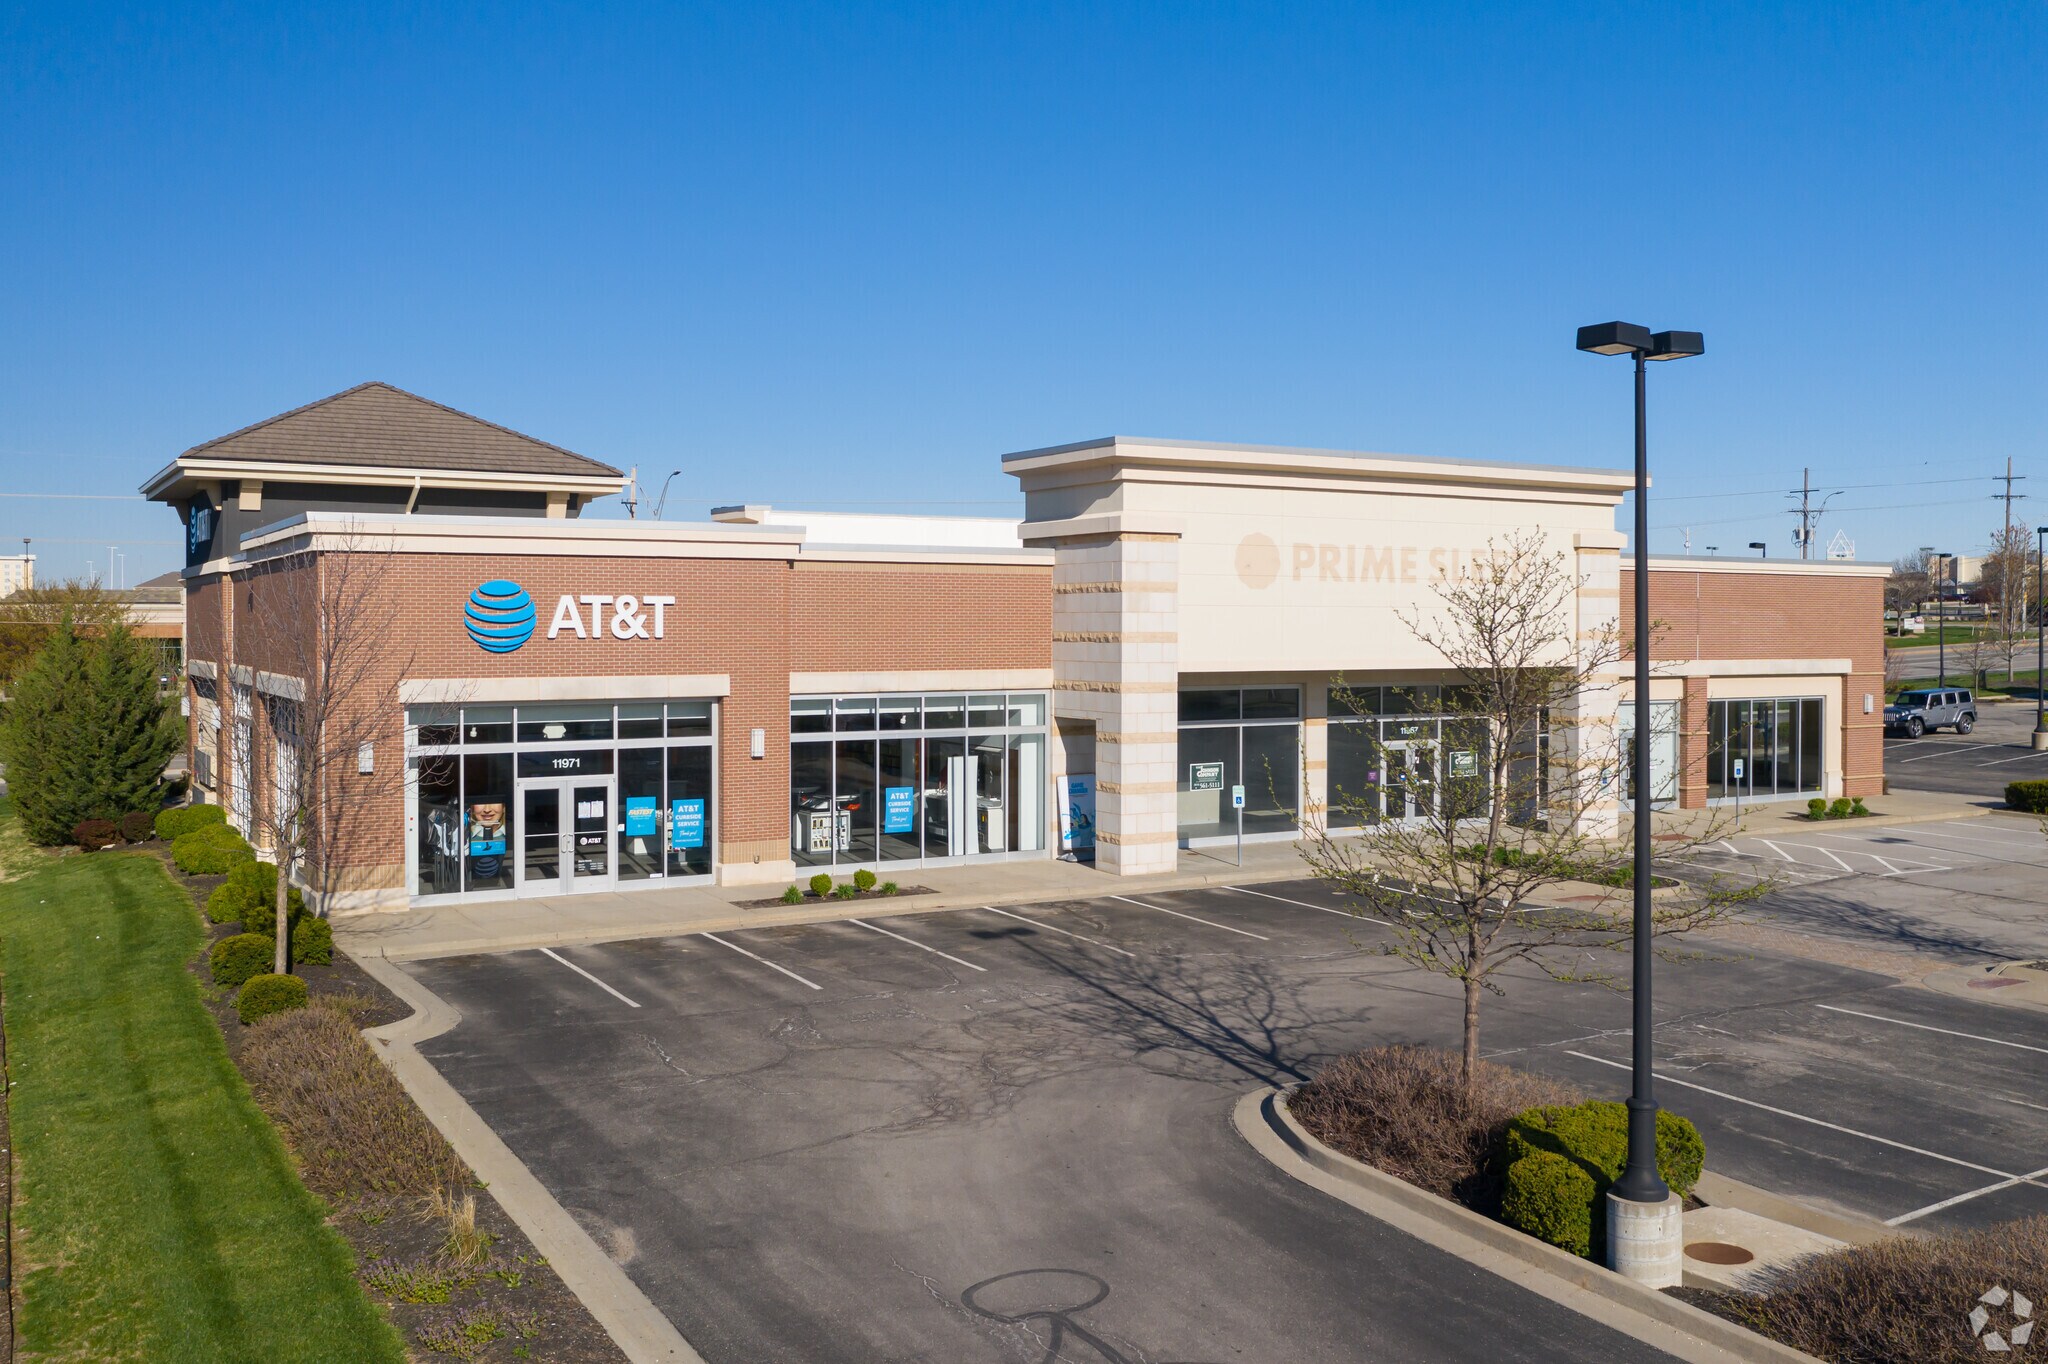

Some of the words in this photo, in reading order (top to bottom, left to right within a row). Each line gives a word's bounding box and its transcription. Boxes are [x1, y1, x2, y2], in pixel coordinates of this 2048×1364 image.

[1292, 542, 1417, 584] PRIME
[546, 594, 676, 641] AT&T
[552, 758, 581, 769] 11971
[890, 792, 910, 800] AT&T
[677, 804, 700, 813] AT&T
[675, 813, 702, 821] CURBSIDE
[677, 820, 700, 828] SERVICE
